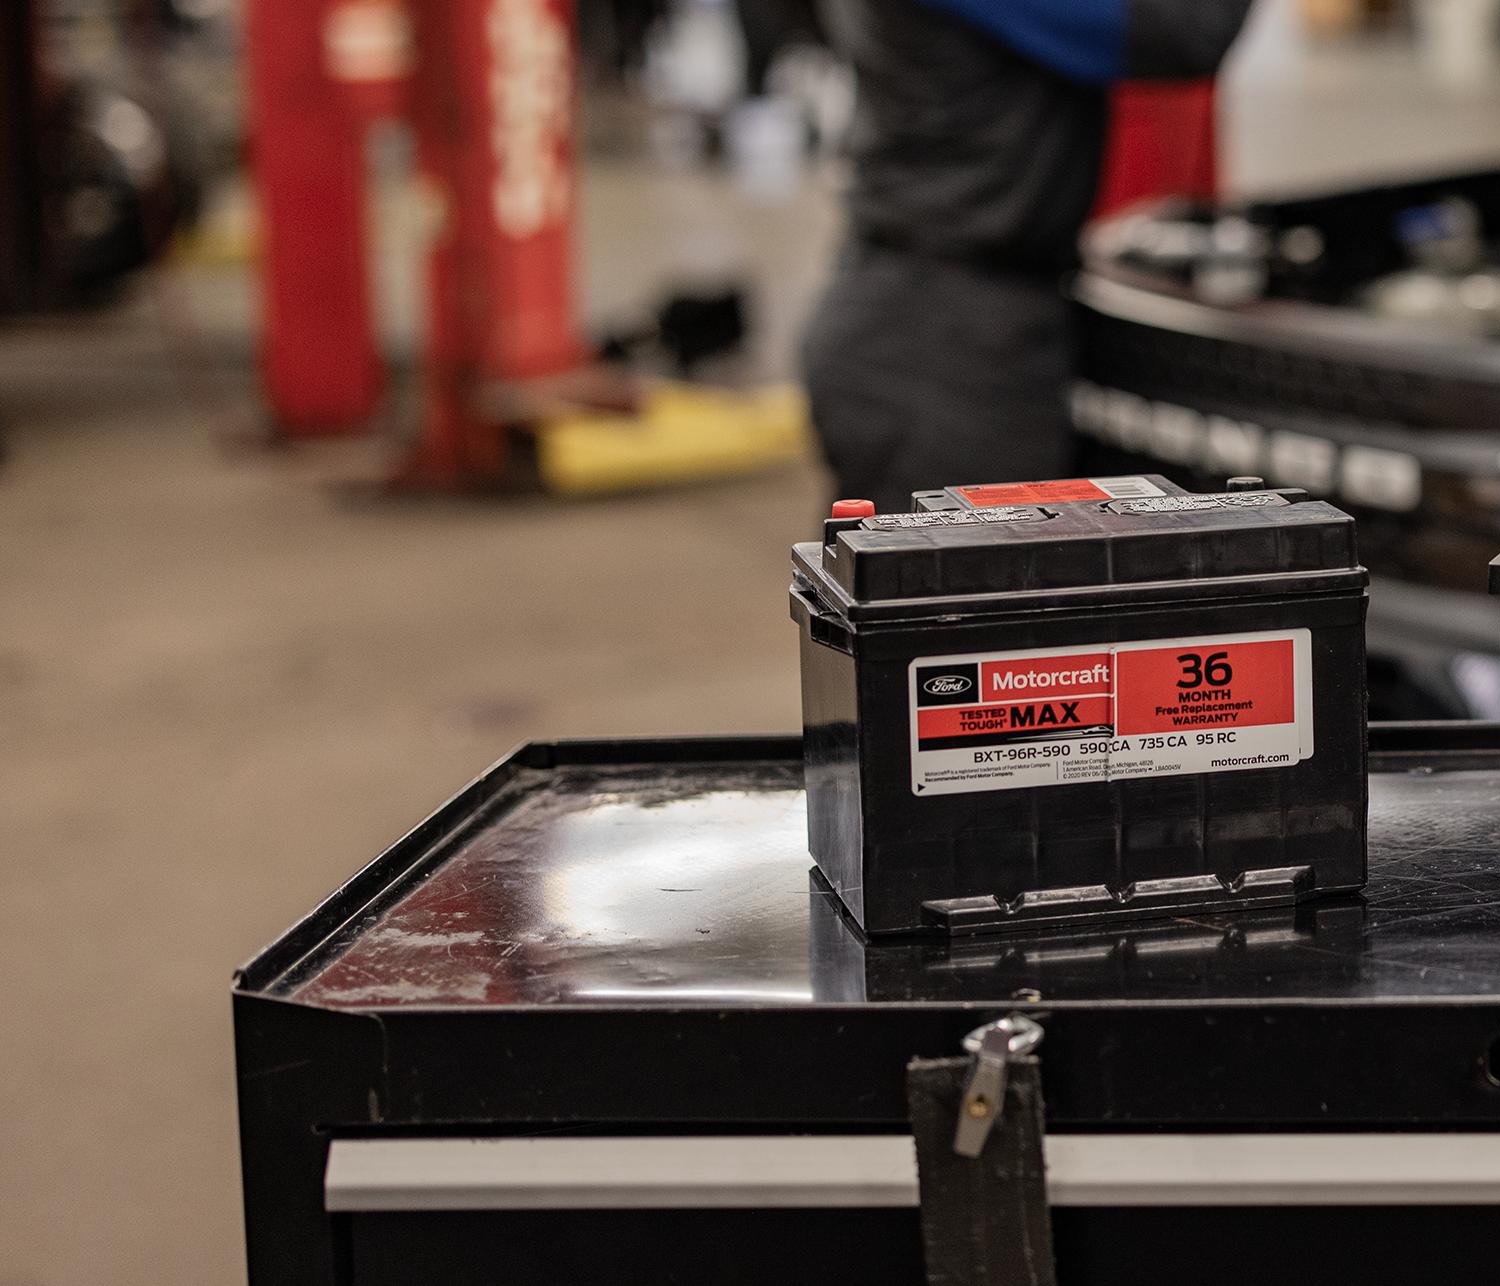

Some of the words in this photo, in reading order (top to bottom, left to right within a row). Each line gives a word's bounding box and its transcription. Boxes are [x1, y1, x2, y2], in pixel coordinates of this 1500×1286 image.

[992, 664, 1110, 691] Motorcraft
[1176, 652, 1233, 689] 36
[932, 678, 963, 692] Ford
[1178, 689, 1231, 703] MONTH
[960, 708, 1006, 720] TESTED
[1010, 702, 1080, 728] MAX
[1155, 706, 1179, 716] Free
[1181, 700, 1253, 714] Replacement
[1172, 713, 1238, 725] WARRANTY
[974, 745, 1070, 763] BXT-96R-590
[1080, 742, 1108, 755] 590
[1139, 737, 1164, 750] 735
[1167, 735, 1187, 748] CA
[1196, 733, 1214, 745] 95
[1217, 731, 1236, 744] RC
[1211, 753, 1289, 767] motorcraft.com
